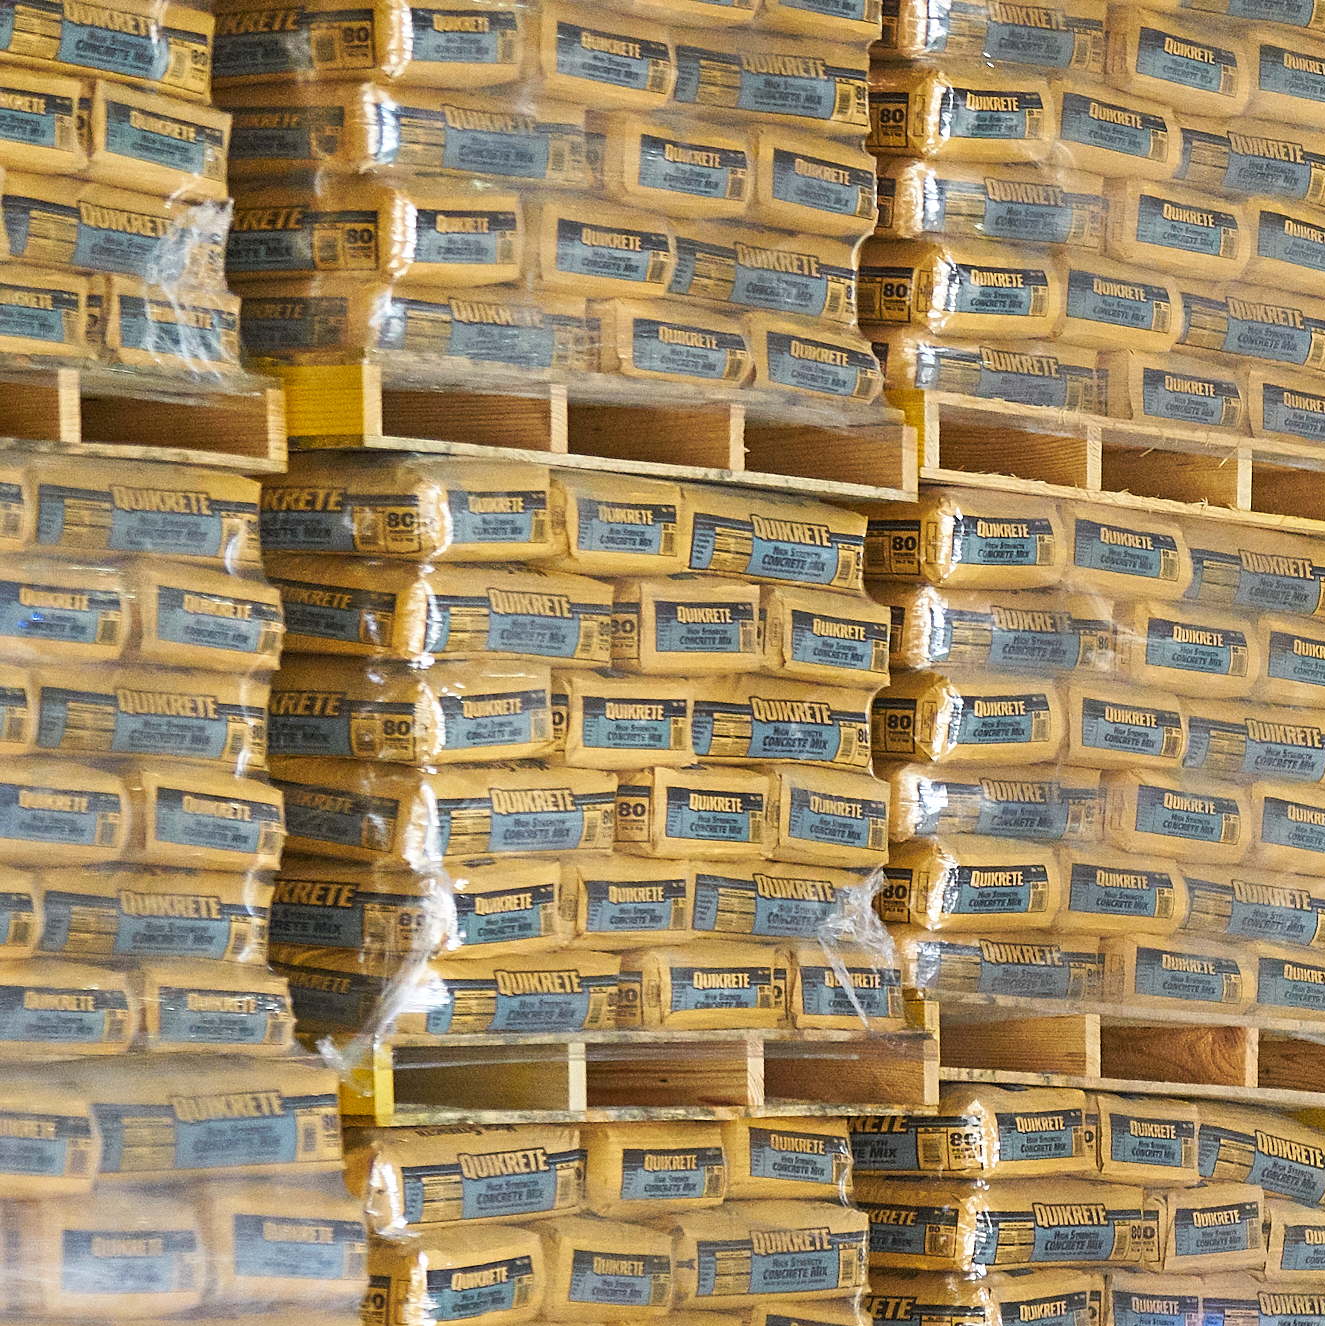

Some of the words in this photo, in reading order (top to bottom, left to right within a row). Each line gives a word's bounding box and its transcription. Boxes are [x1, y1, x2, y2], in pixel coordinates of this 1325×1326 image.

[1163, 38, 1217, 65] QUIKRETE
[965, 93, 1020, 113] QUIKRETE
[970, 270, 1024, 289] QUIKRETE
[1228, 298, 1305, 328] QUIKRETE
[750, 514, 833, 548] QUIKRETE
[976, 519, 1030, 539] QUIKRETE
[1099, 528, 1155, 550] QUIKRETE
[892, 536, 917, 552] 80
[676, 606, 734, 625] QUIKRETE
[1173, 626, 1224, 647] QUIKRETE
[604, 703, 665, 720] QUIKRETE
[750, 697, 833, 726] QUIKRETE
[973, 700, 1026, 717] QUIKRETE
[1247, 720, 1323, 748] QUIKRETE
[489, 788, 576, 814] QUIKRETE
[617, 801, 647, 817] 80
[1016, 1117, 1065, 1133] QUIKRETE
[769, 1135, 826, 1155] QUIKRETE
[1255, 1131, 1325, 1168] QUIKRETE
[459, 1148, 548, 1180] QUIKRETE
[1033, 1203, 1109, 1228] QUIKRETE
[750, 1228, 832, 1254] QUIKRETE
